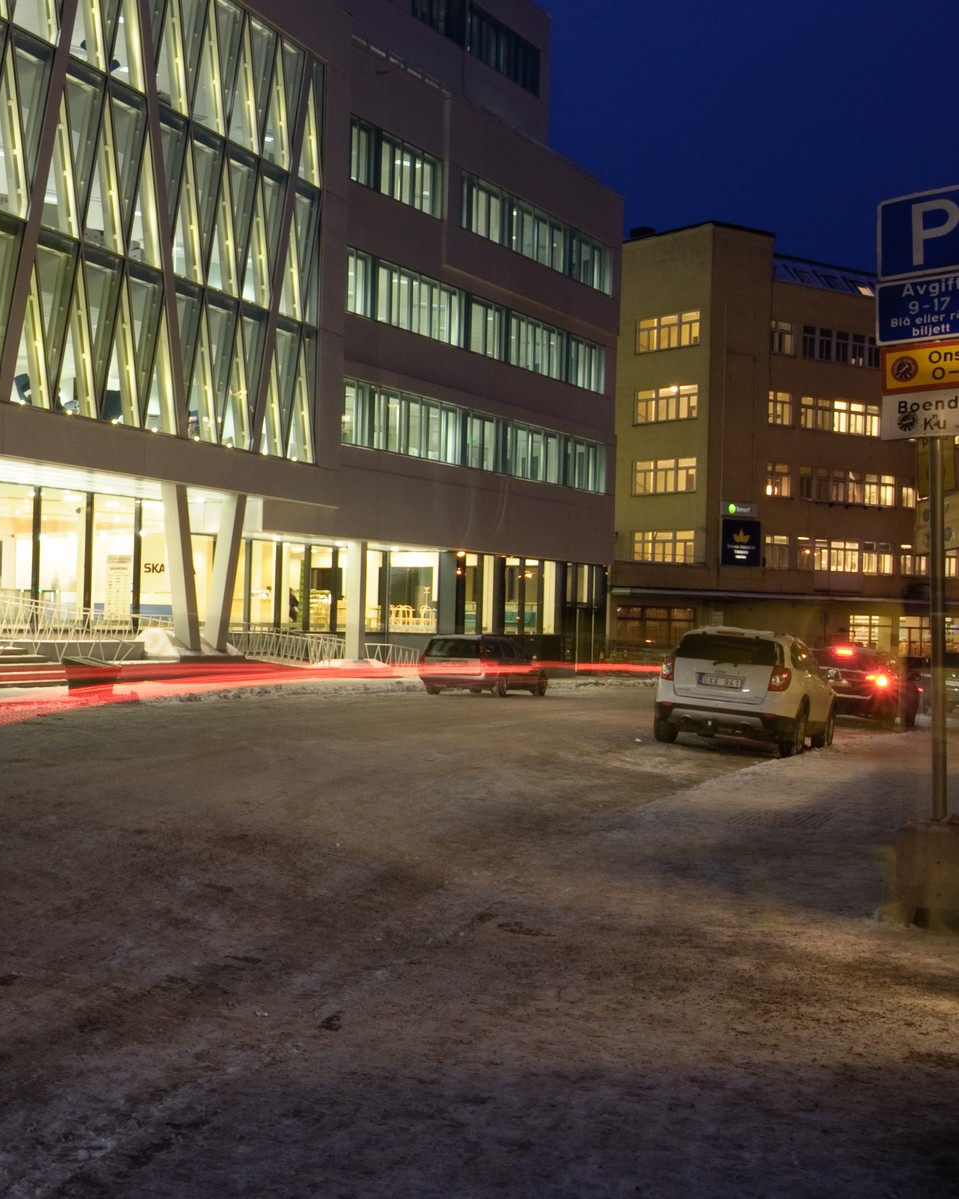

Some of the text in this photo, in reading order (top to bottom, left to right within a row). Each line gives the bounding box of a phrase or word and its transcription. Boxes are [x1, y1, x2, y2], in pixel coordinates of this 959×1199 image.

[912, 199, 959, 266] P
[891, 316, 911, 328] Blå
[915, 313, 946, 324] eller
[912, 323, 951, 337] biljett
[898, 395, 959, 414] Boend
